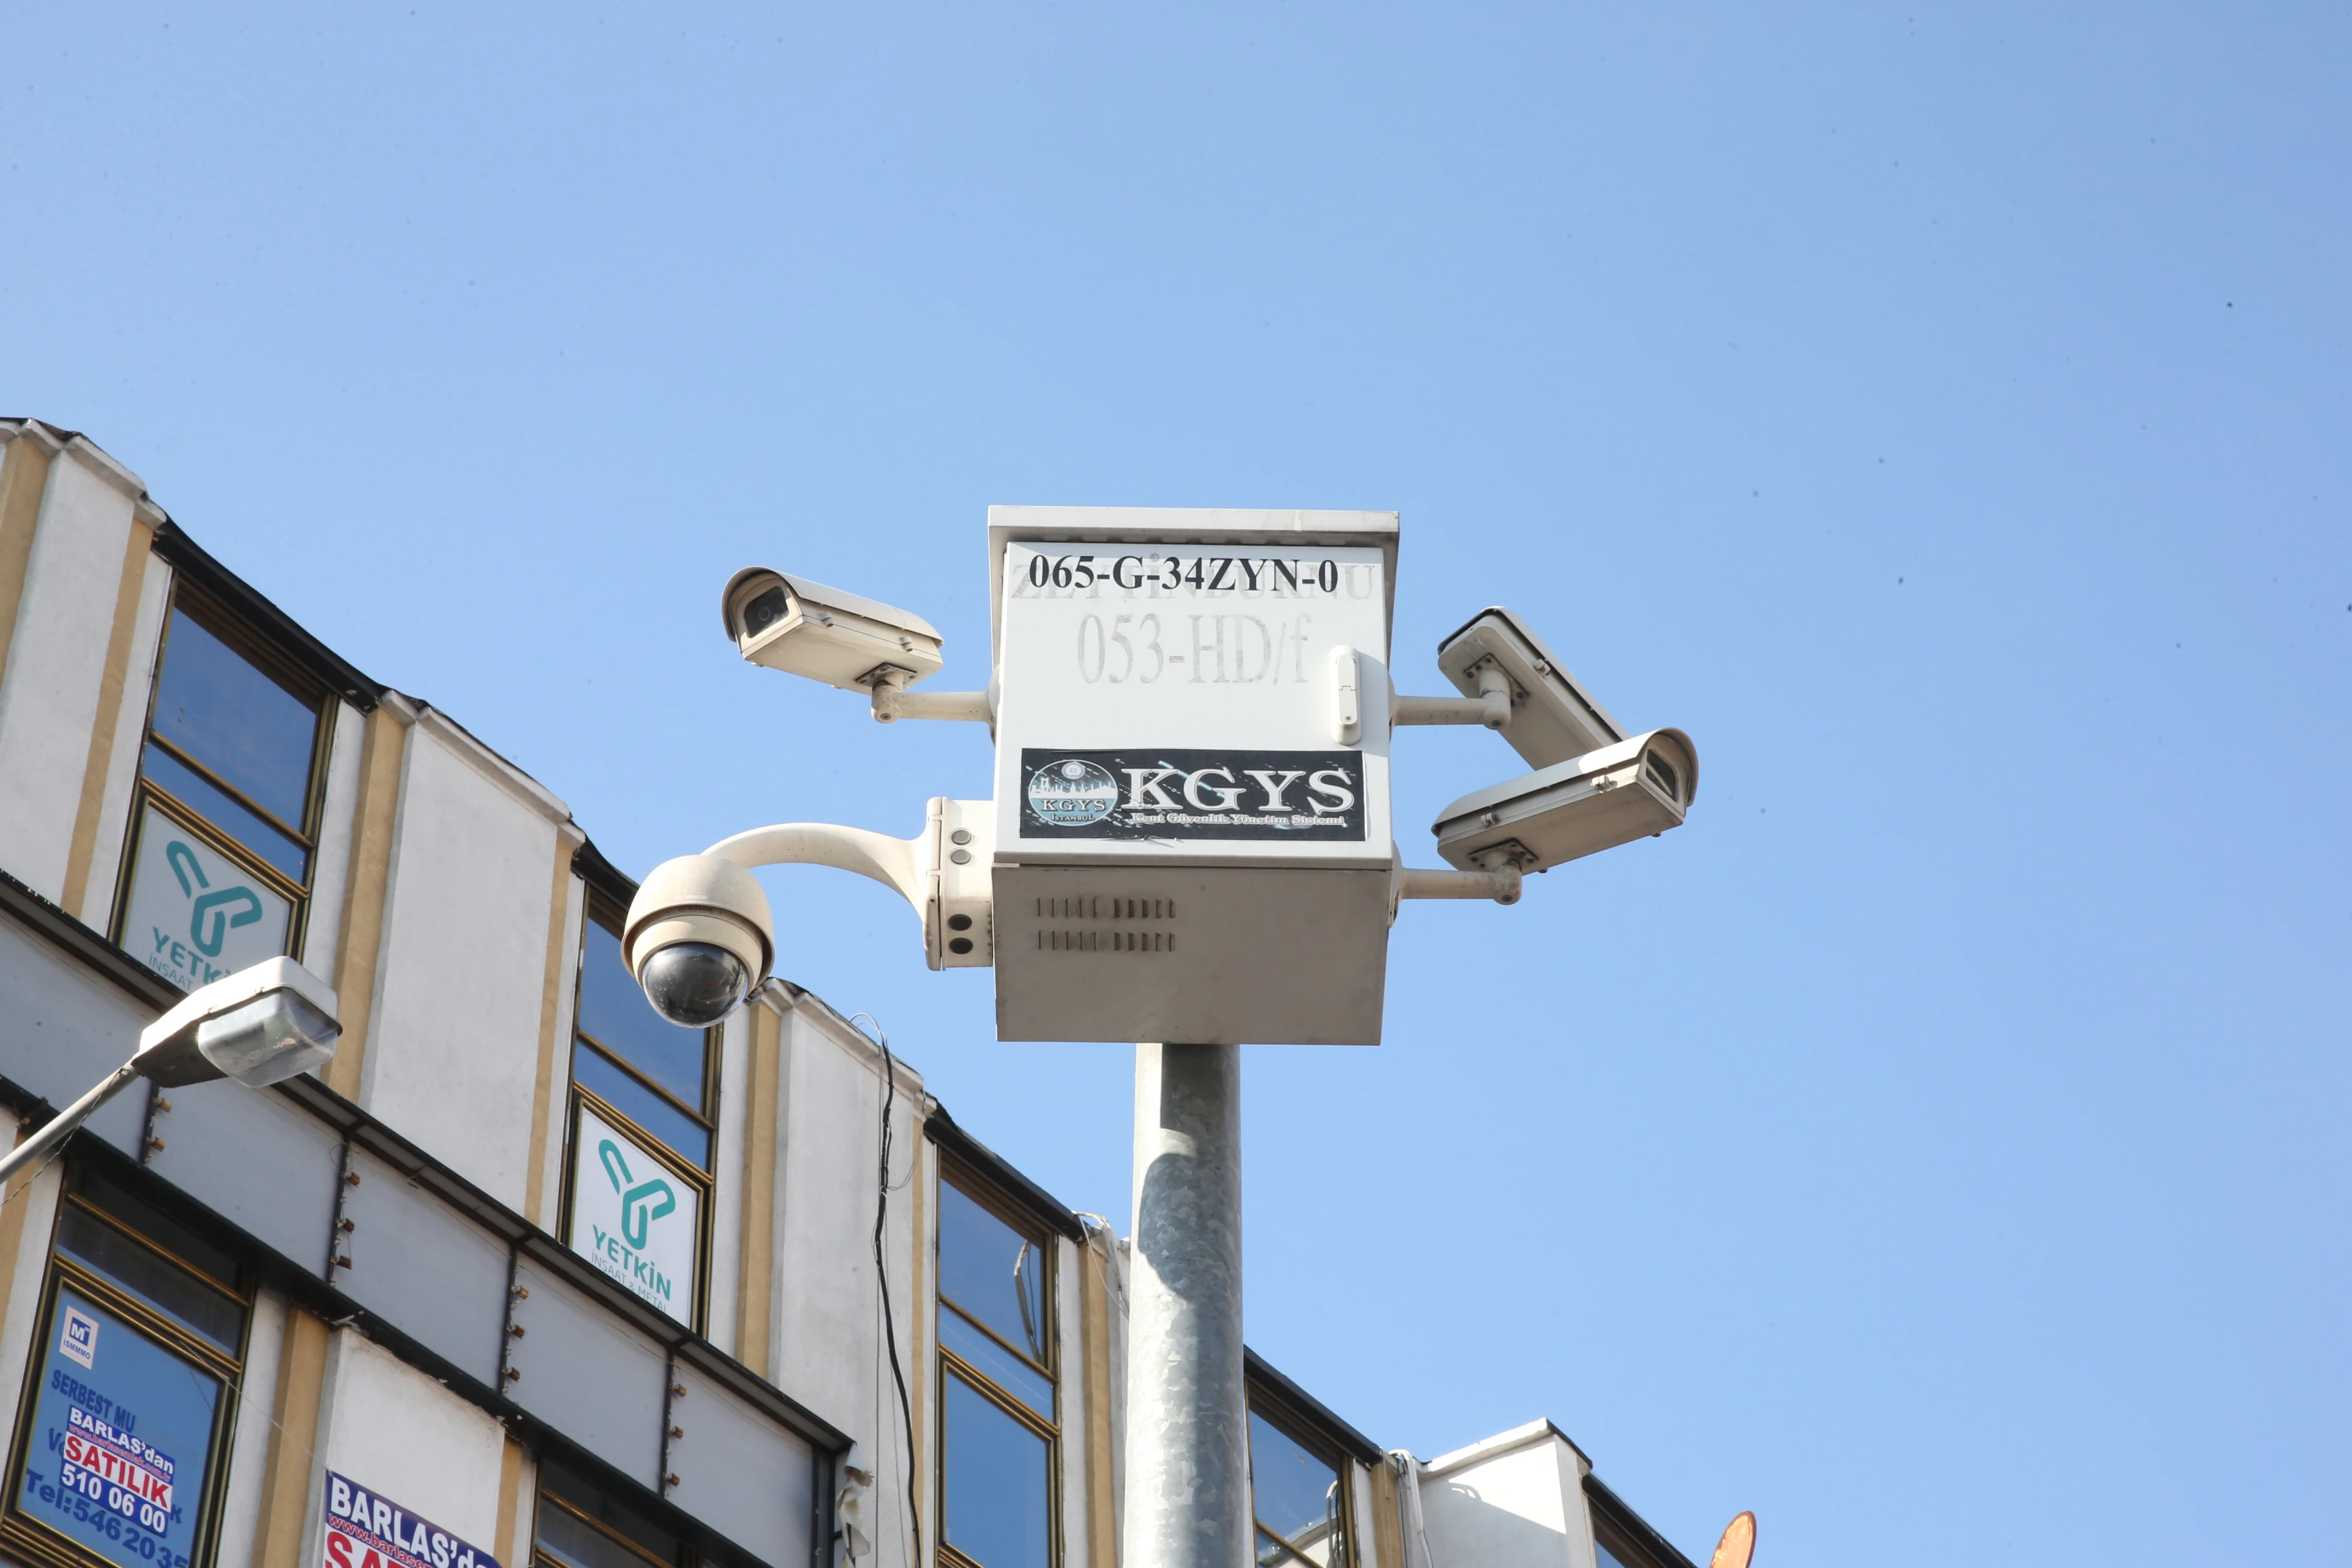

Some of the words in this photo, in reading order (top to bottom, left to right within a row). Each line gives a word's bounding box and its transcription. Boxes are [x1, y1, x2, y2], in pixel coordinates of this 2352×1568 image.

[1029, 555, 1339, 592] 065-G-34ZYN-0
[1077, 612, 1312, 685] 053-HD/f
[1042, 799, 1106, 812] KGYS
[1121, 767, 1355, 815] KGYS
[1130, 812, 1166, 824] Kent
[152, 926, 231, 985] YETK
[592, 1224, 671, 1301] YETKİN
[52, 1369, 113, 1419] SERBEST
[114, 1405, 136, 1433] MU
[61, 1463, 102, 1500] 510
[109, 1487, 136, 1516] 06
[139, 1503, 166, 1533] 00
[65, 1435, 169, 1509] SATILIK
